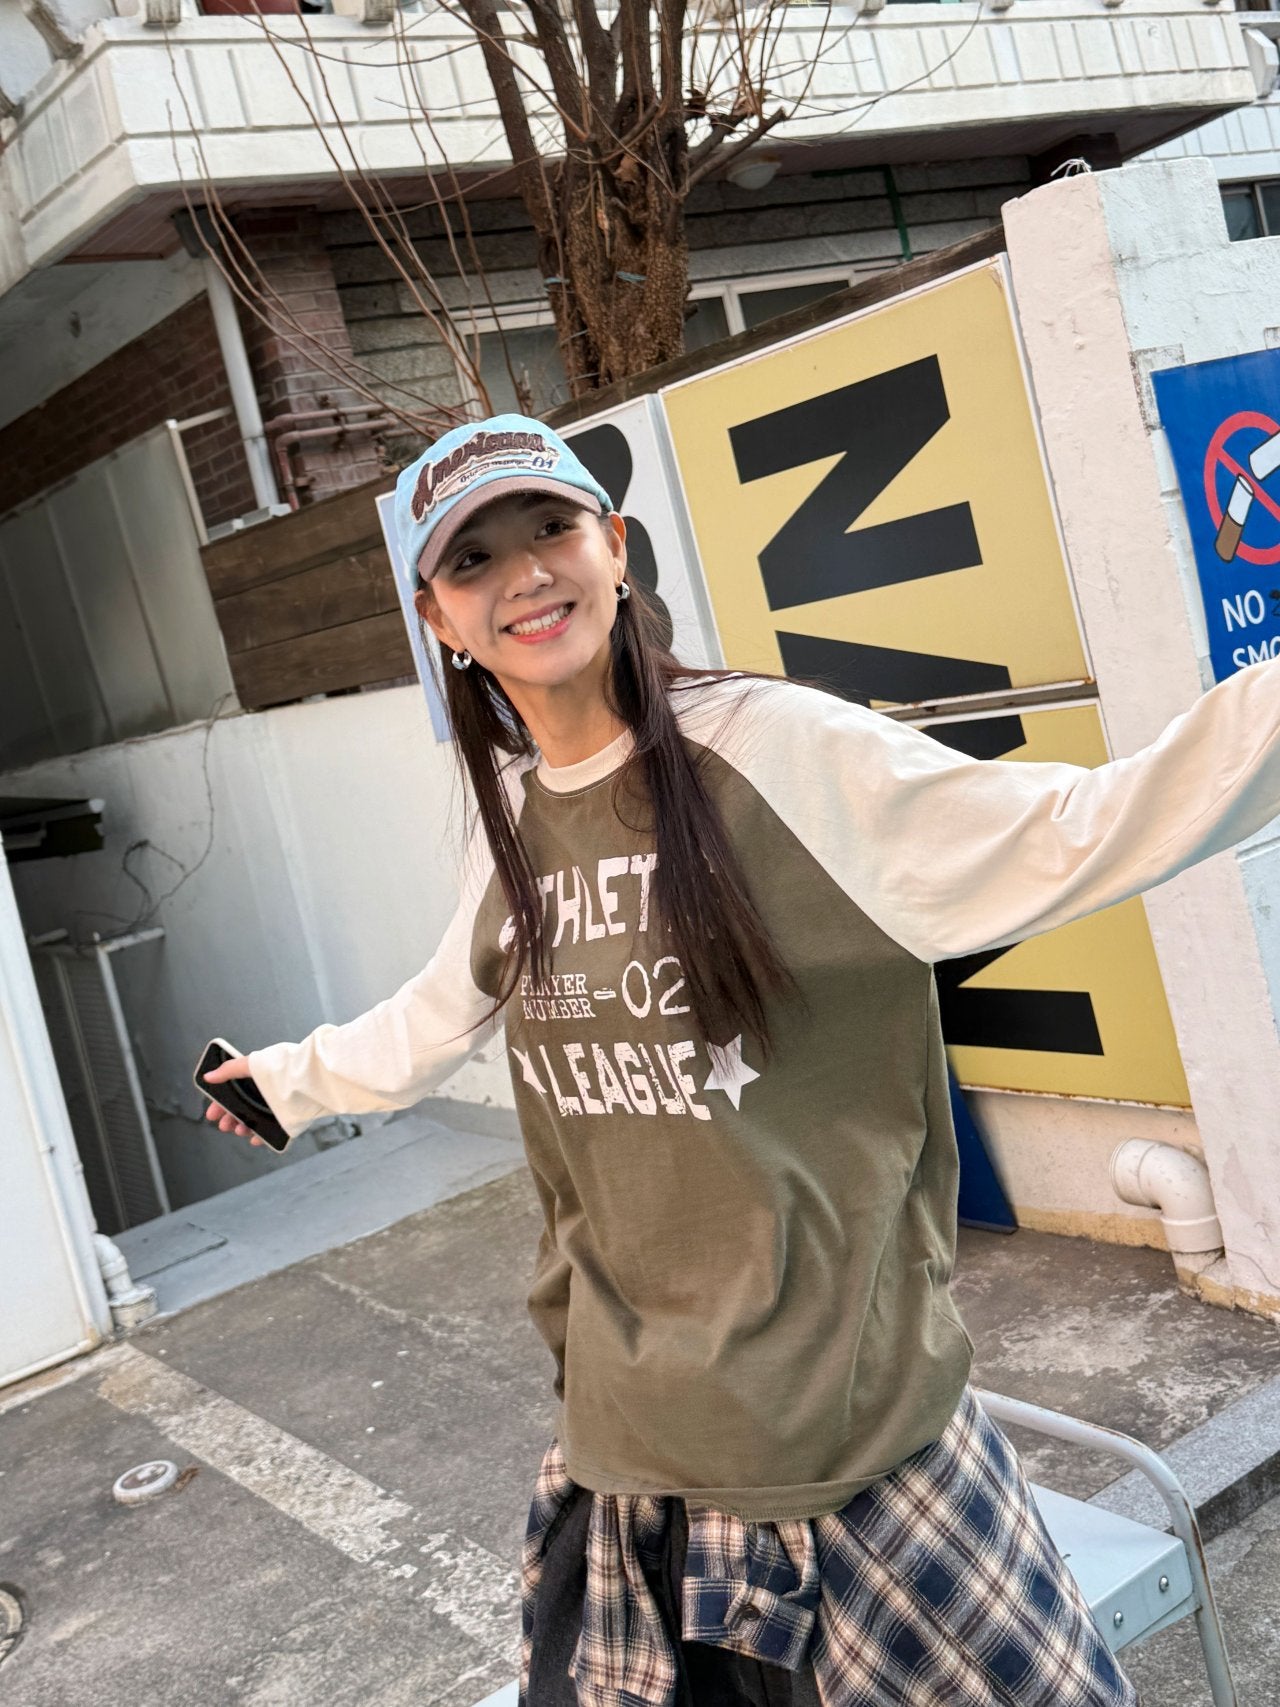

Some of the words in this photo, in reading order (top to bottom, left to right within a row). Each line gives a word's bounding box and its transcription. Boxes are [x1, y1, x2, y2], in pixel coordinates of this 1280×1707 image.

[1221, 589, 1265, 632] NO
[523, 998, 596, 1021] NUMBER
[539, 1040, 712, 1121] LEAGUE
